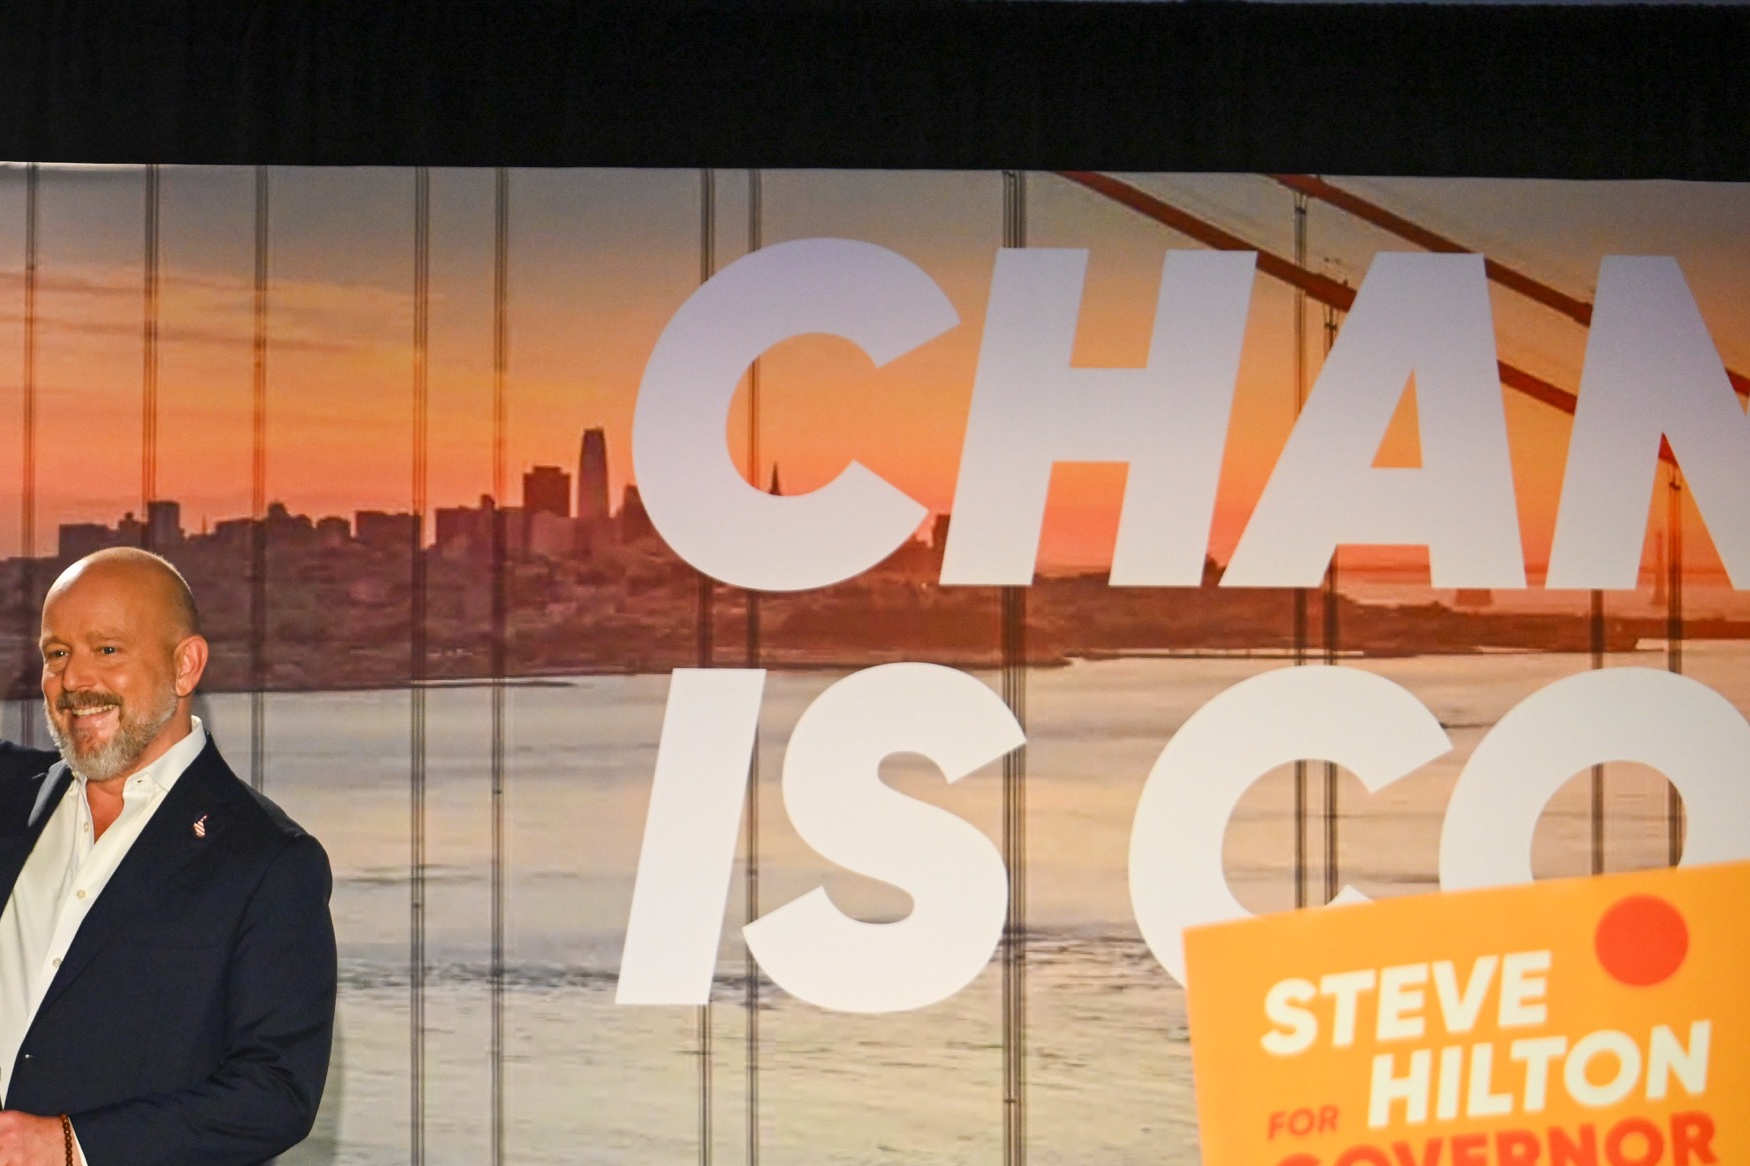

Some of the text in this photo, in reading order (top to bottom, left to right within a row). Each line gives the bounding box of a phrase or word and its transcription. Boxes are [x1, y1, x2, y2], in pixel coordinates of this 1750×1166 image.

[614, 662, 1028, 1013] IS
[1260, 949, 1552, 1057] STEVE
[1266, 1105, 1340, 1140] FOR
[1367, 1020, 1712, 1129] HILTON
